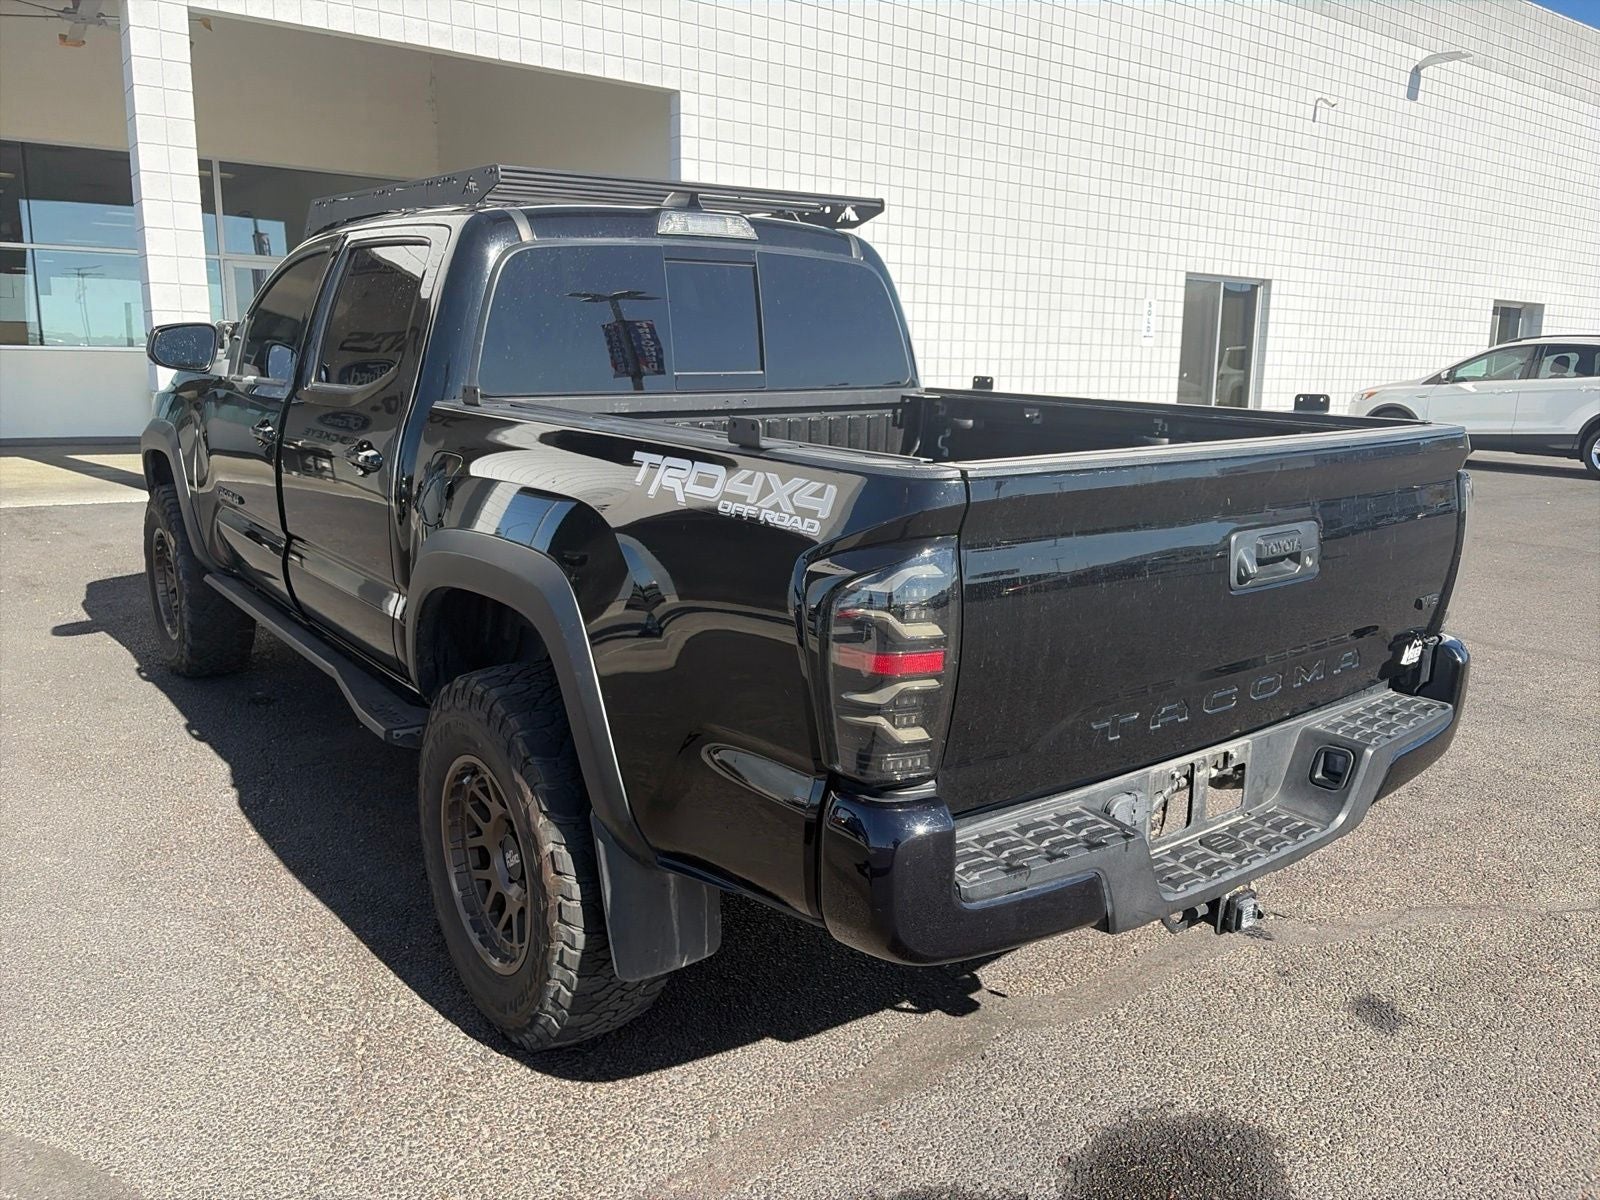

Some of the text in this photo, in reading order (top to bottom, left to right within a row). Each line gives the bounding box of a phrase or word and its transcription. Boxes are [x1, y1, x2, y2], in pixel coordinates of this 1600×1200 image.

[632, 450, 838, 520] TRD 4X4
[717, 500, 821, 536] OFF ROAD
[1264, 537, 1302, 556] TOYOTA
[1091, 648, 1361, 741] TACOMA
